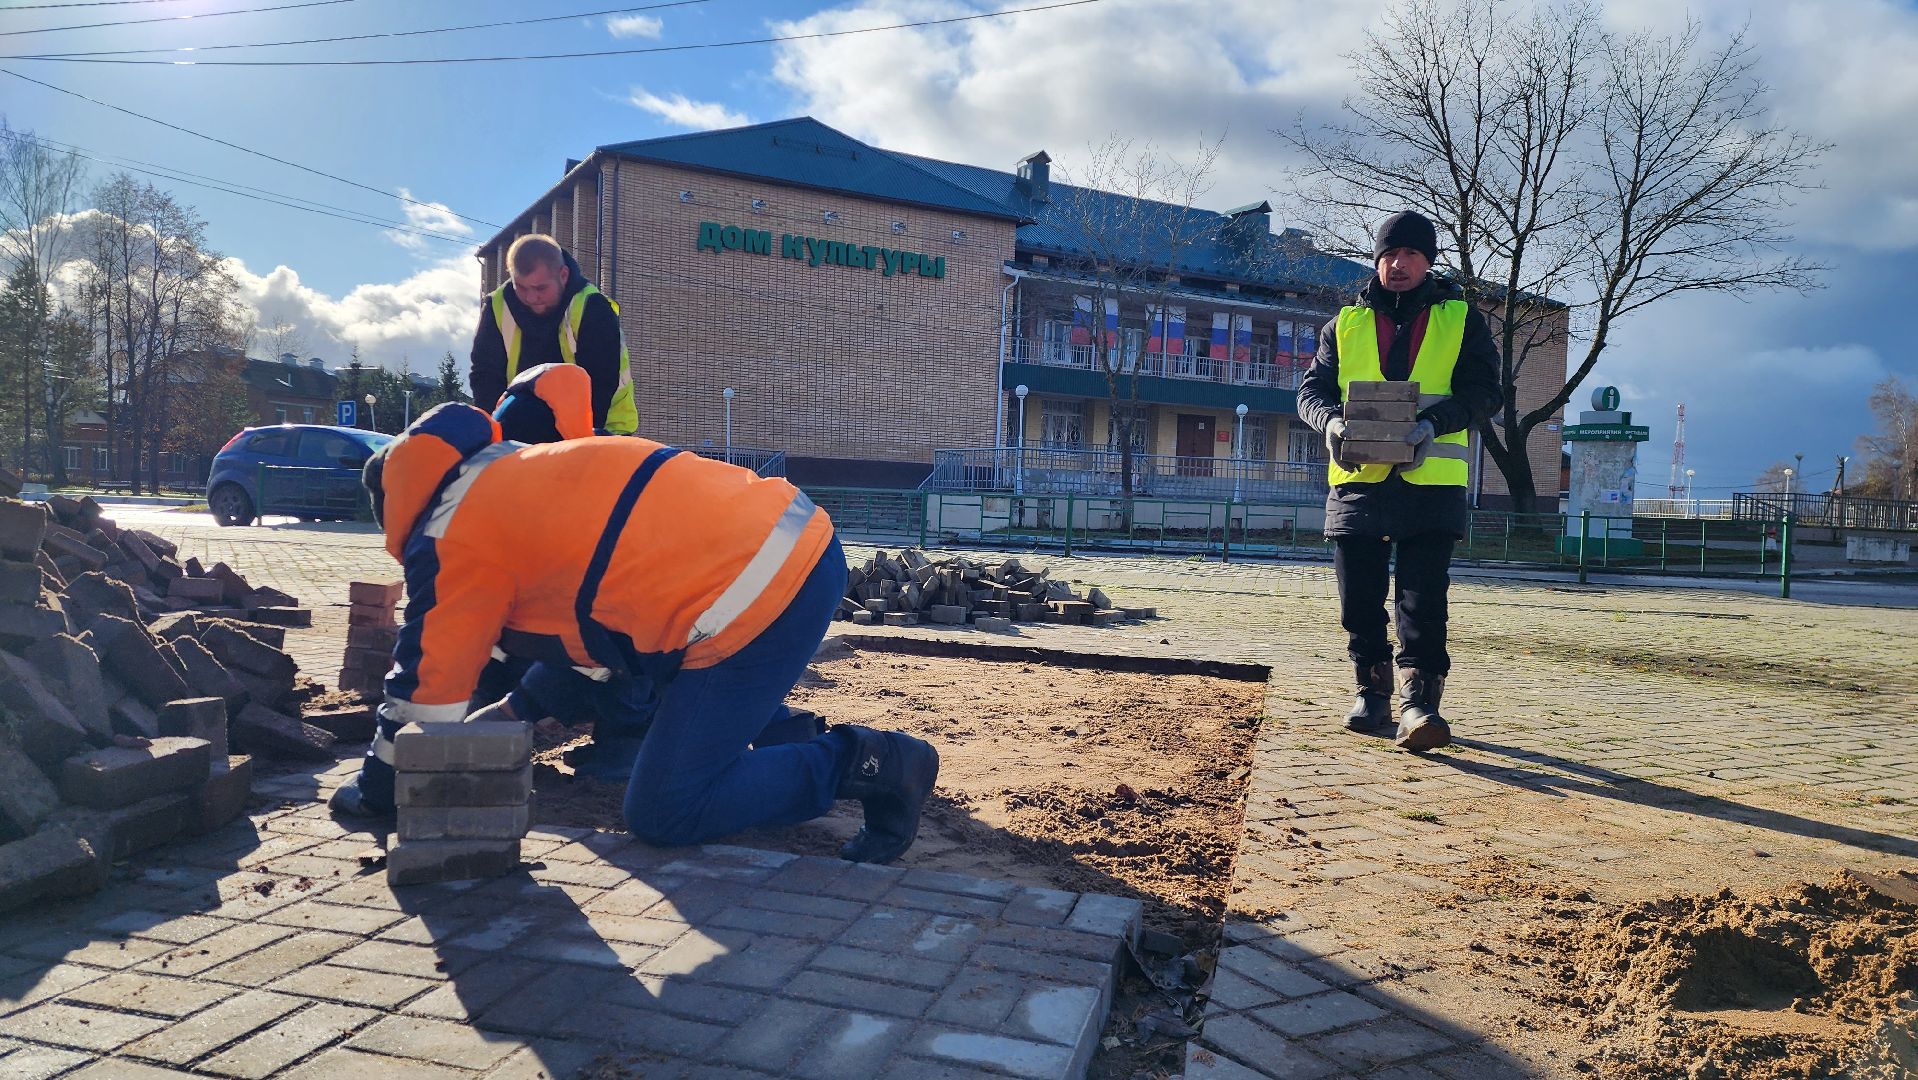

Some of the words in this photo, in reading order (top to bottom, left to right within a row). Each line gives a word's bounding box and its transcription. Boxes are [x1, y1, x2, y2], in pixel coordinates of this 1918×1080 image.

[697, 221, 772, 257] ДОМ
[782, 233, 945, 279] КУЛЬТУРЫ
[342, 404, 352, 423] P
